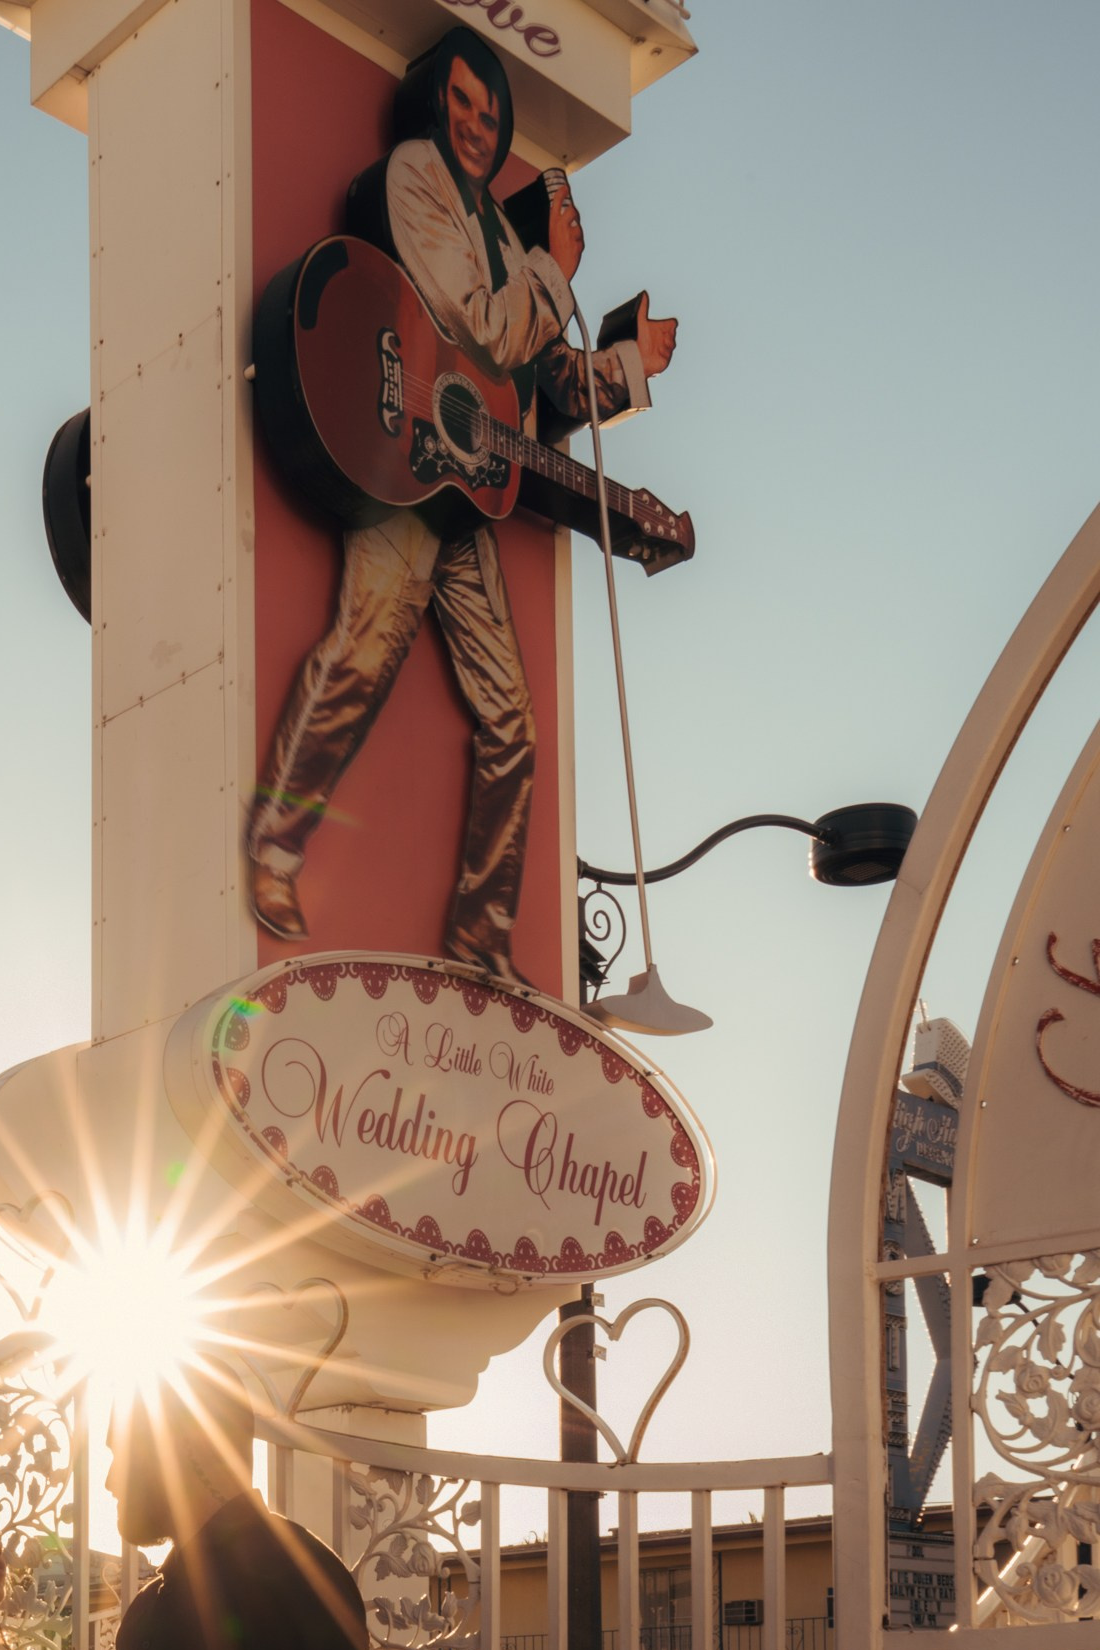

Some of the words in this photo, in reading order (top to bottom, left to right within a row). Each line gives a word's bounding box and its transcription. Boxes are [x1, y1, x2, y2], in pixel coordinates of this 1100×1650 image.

[442, 0, 561, 57] ve
[376, 1011, 414, 1066] A
[424, 1022, 483, 1076] Little
[489, 1041, 554, 1096] White
[262, 1037, 479, 1197] Wedding
[497, 1099, 648, 1227] Chapel
